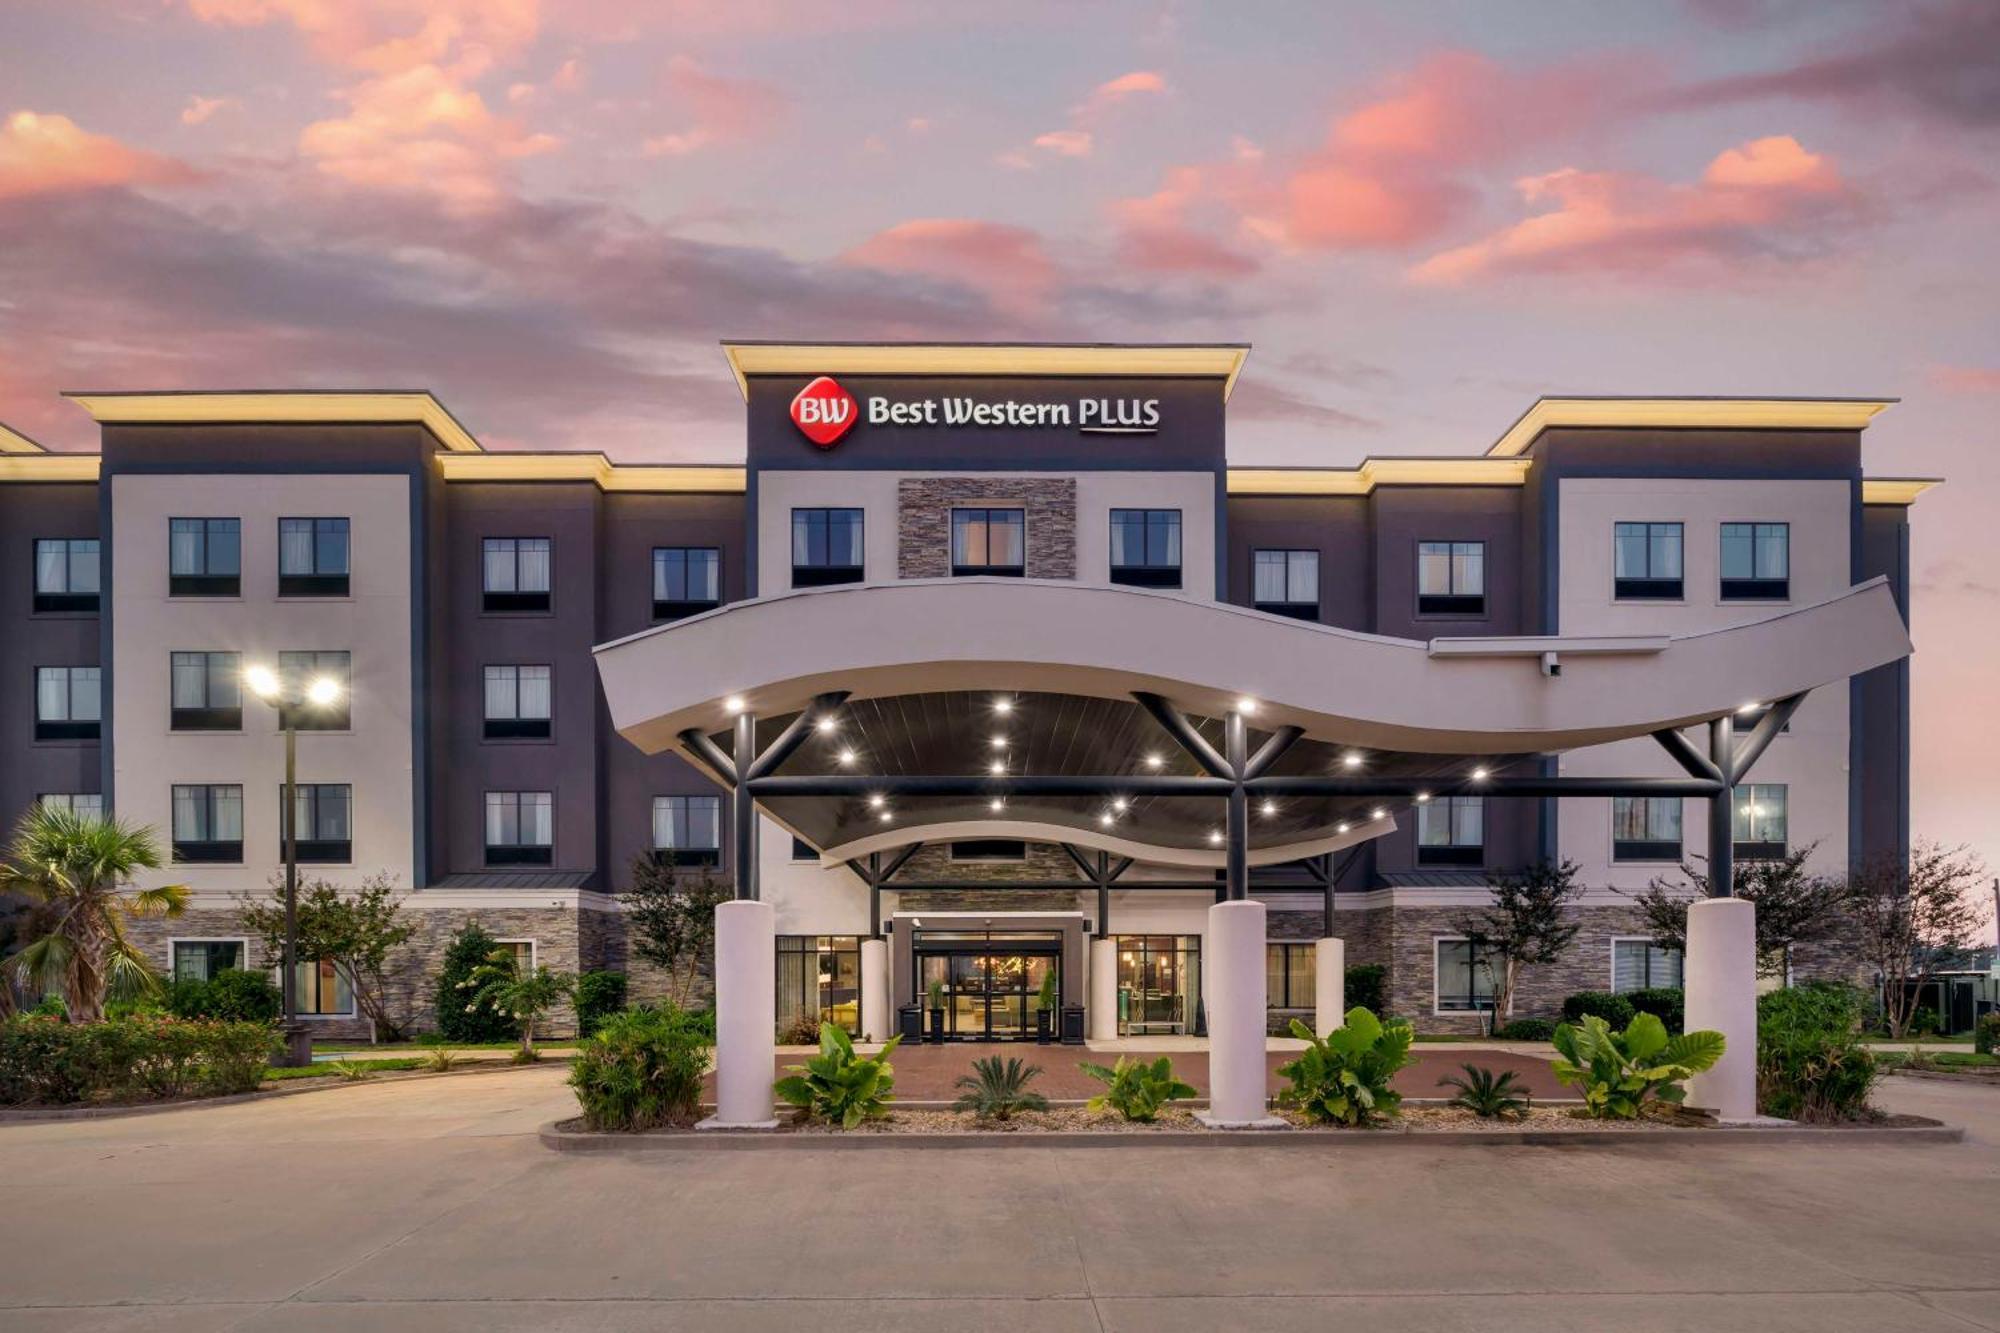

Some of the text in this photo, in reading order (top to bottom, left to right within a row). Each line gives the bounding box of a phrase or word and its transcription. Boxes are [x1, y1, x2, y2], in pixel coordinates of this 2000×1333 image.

[799, 397, 849, 424] BW
[869, 397, 1160, 426] Best Western PLUS
